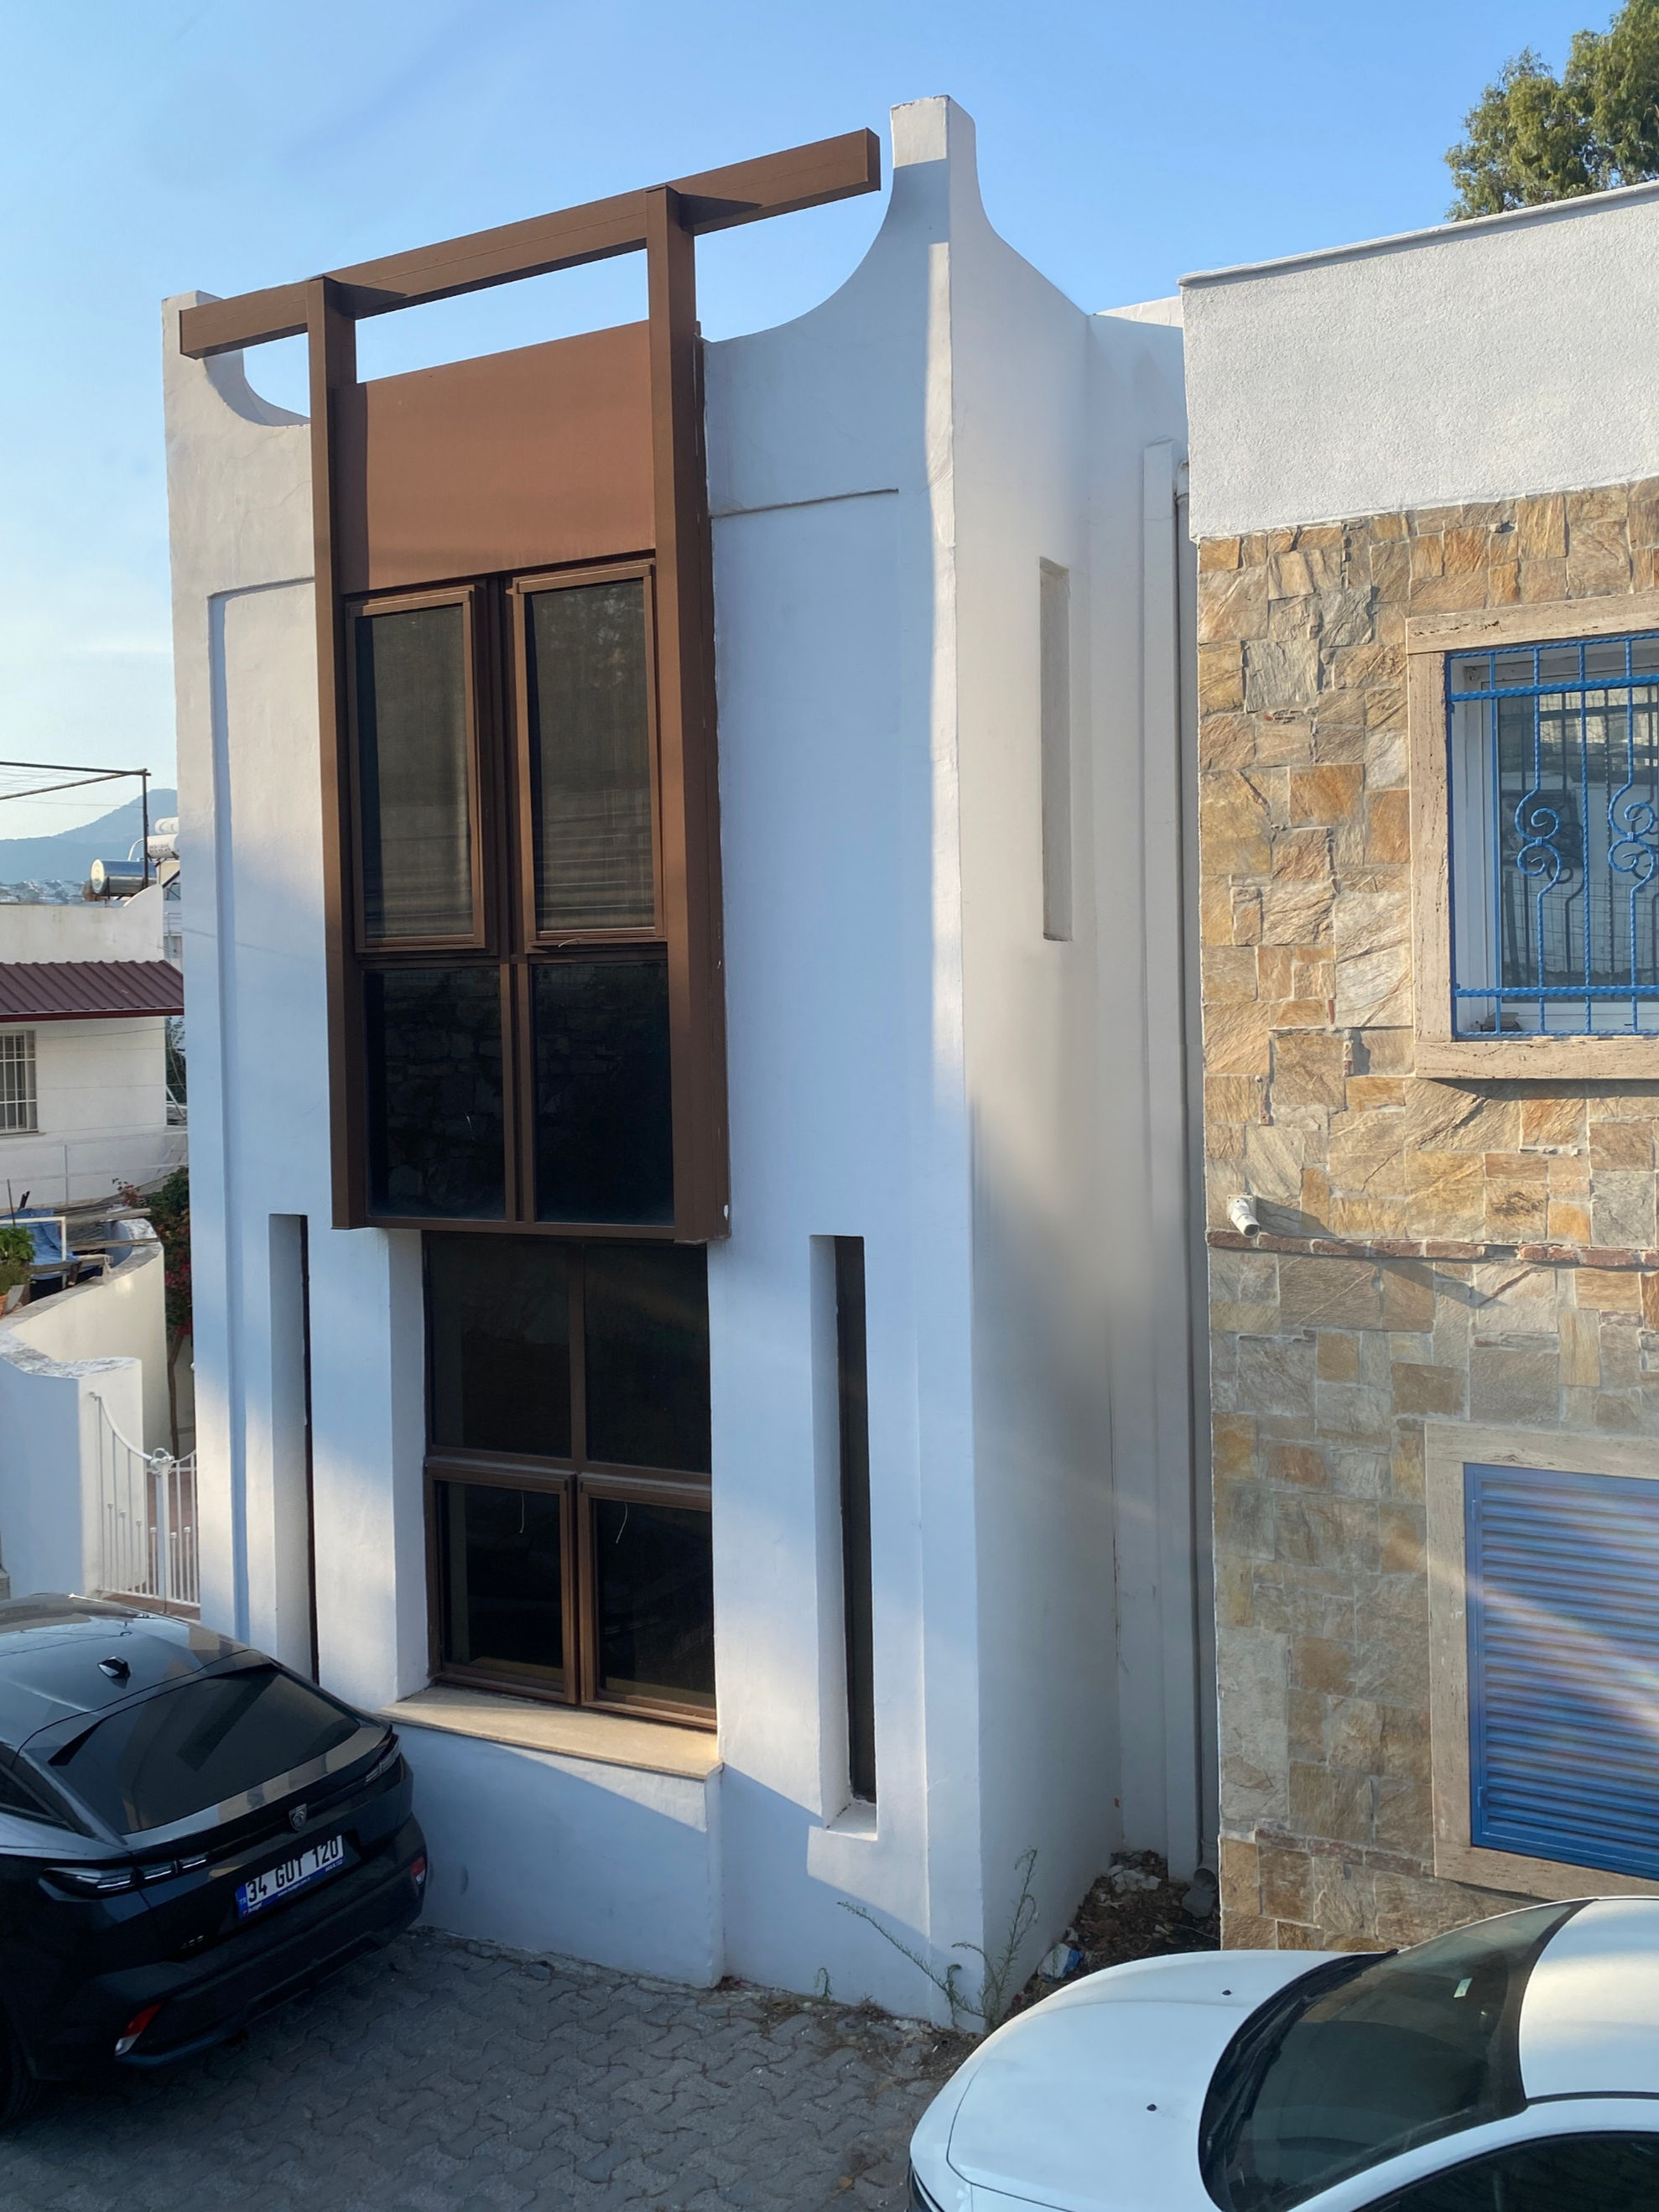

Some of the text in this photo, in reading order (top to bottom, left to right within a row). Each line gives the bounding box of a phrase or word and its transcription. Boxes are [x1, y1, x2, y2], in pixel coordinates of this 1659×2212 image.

[247, 1876, 268, 1902] 34
[275, 1856, 303, 1888] GUT
[312, 1839, 339, 1868] 120
